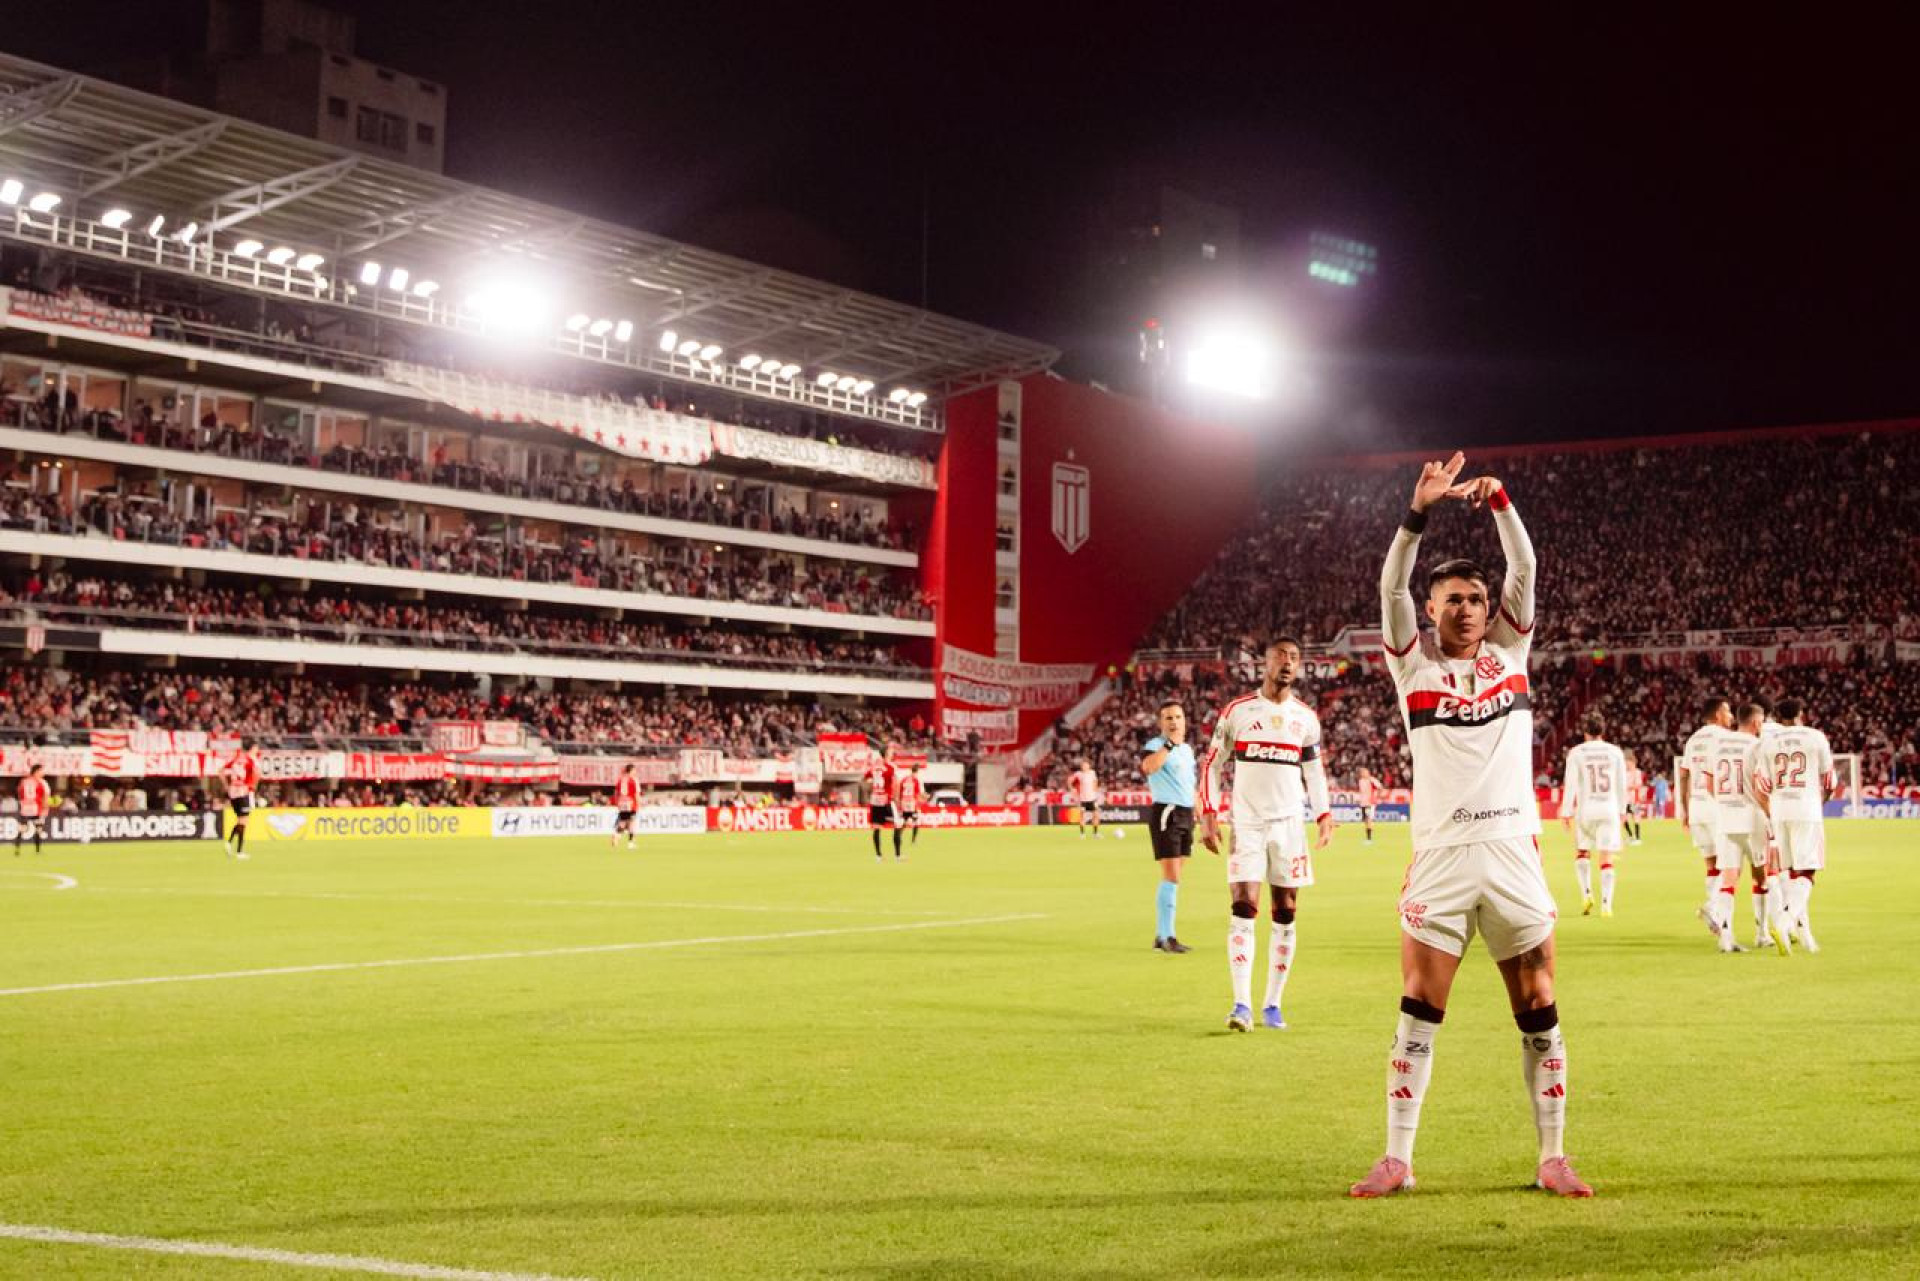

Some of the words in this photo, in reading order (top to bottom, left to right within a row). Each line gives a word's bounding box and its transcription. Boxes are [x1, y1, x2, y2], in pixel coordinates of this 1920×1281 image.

[1434, 689, 1515, 721] Betano
[1245, 743, 1300, 762] Betano
[261, 756, 323, 776] ORESTA
[1717, 759, 1744, 795] 21
[1774, 751, 1807, 790] 22
[1586, 764, 1611, 793] 15
[315, 812, 412, 835] mercado
[416, 812, 459, 834] libre
[531, 814, 602, 830] HYUNDAI
[639, 812, 703, 829] HYUNDAI
[735, 809, 793, 831] AMSTEL
[817, 807, 869, 829] AMSTEL
[1474, 807, 1520, 821] ADEMICON
[51, 815, 197, 839] LIBERTADORES
[1290, 855, 1309, 878] 27
